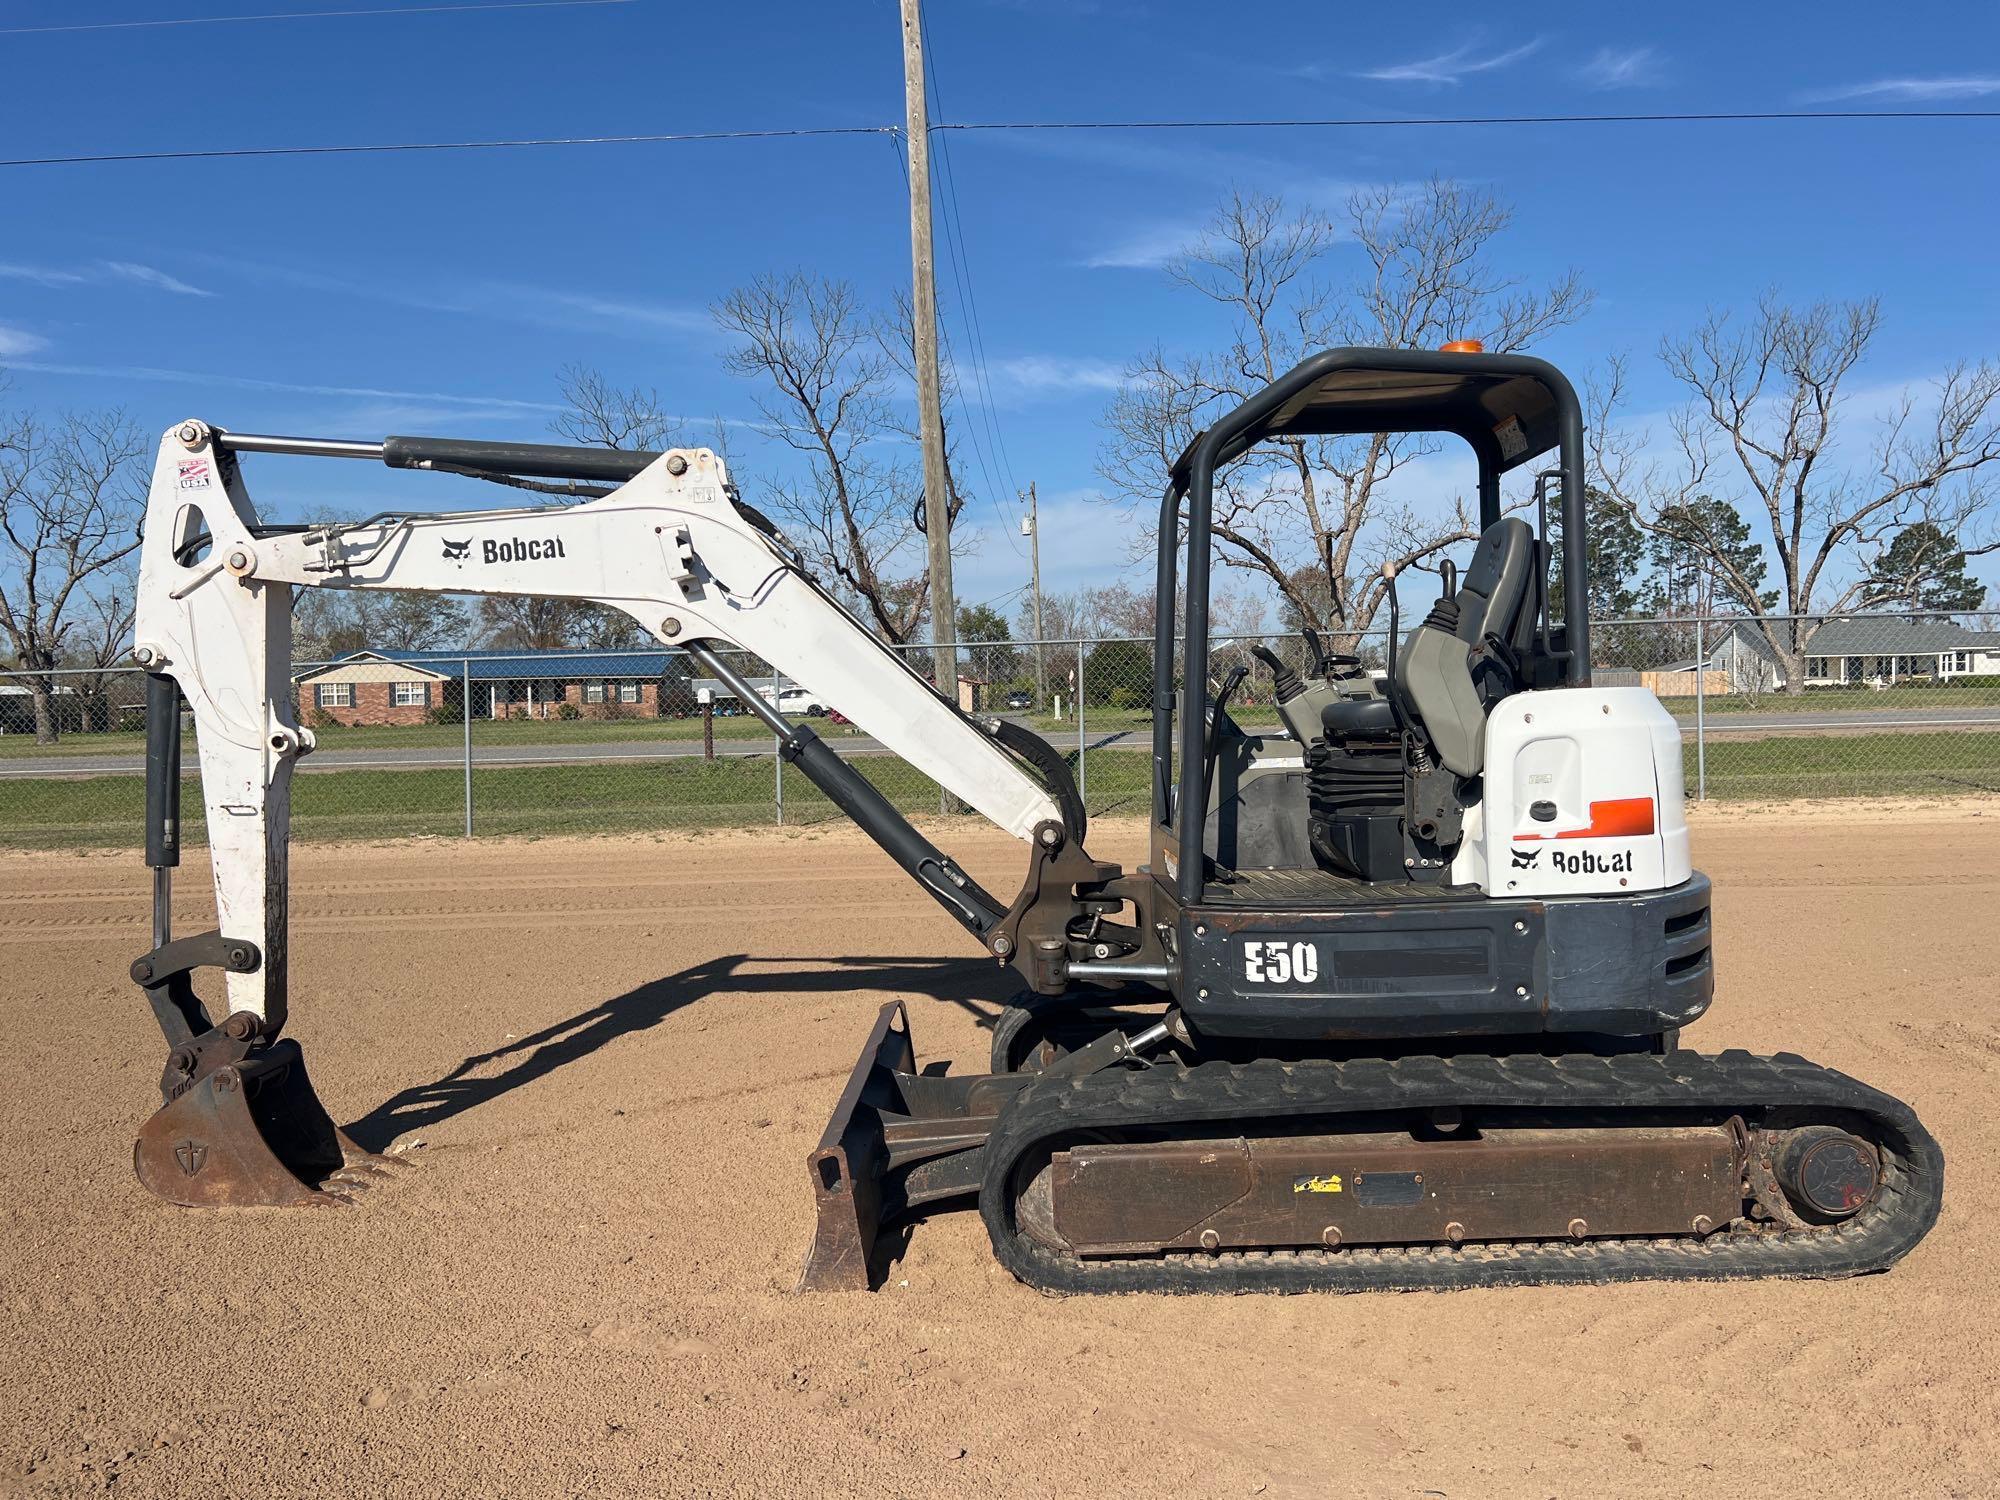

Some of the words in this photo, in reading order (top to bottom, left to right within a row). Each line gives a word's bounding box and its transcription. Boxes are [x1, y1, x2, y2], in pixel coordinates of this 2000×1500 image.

[182, 479, 208, 488] USA
[483, 535, 565, 564] Bobcat
[1244, 941, 1318, 983] E50
